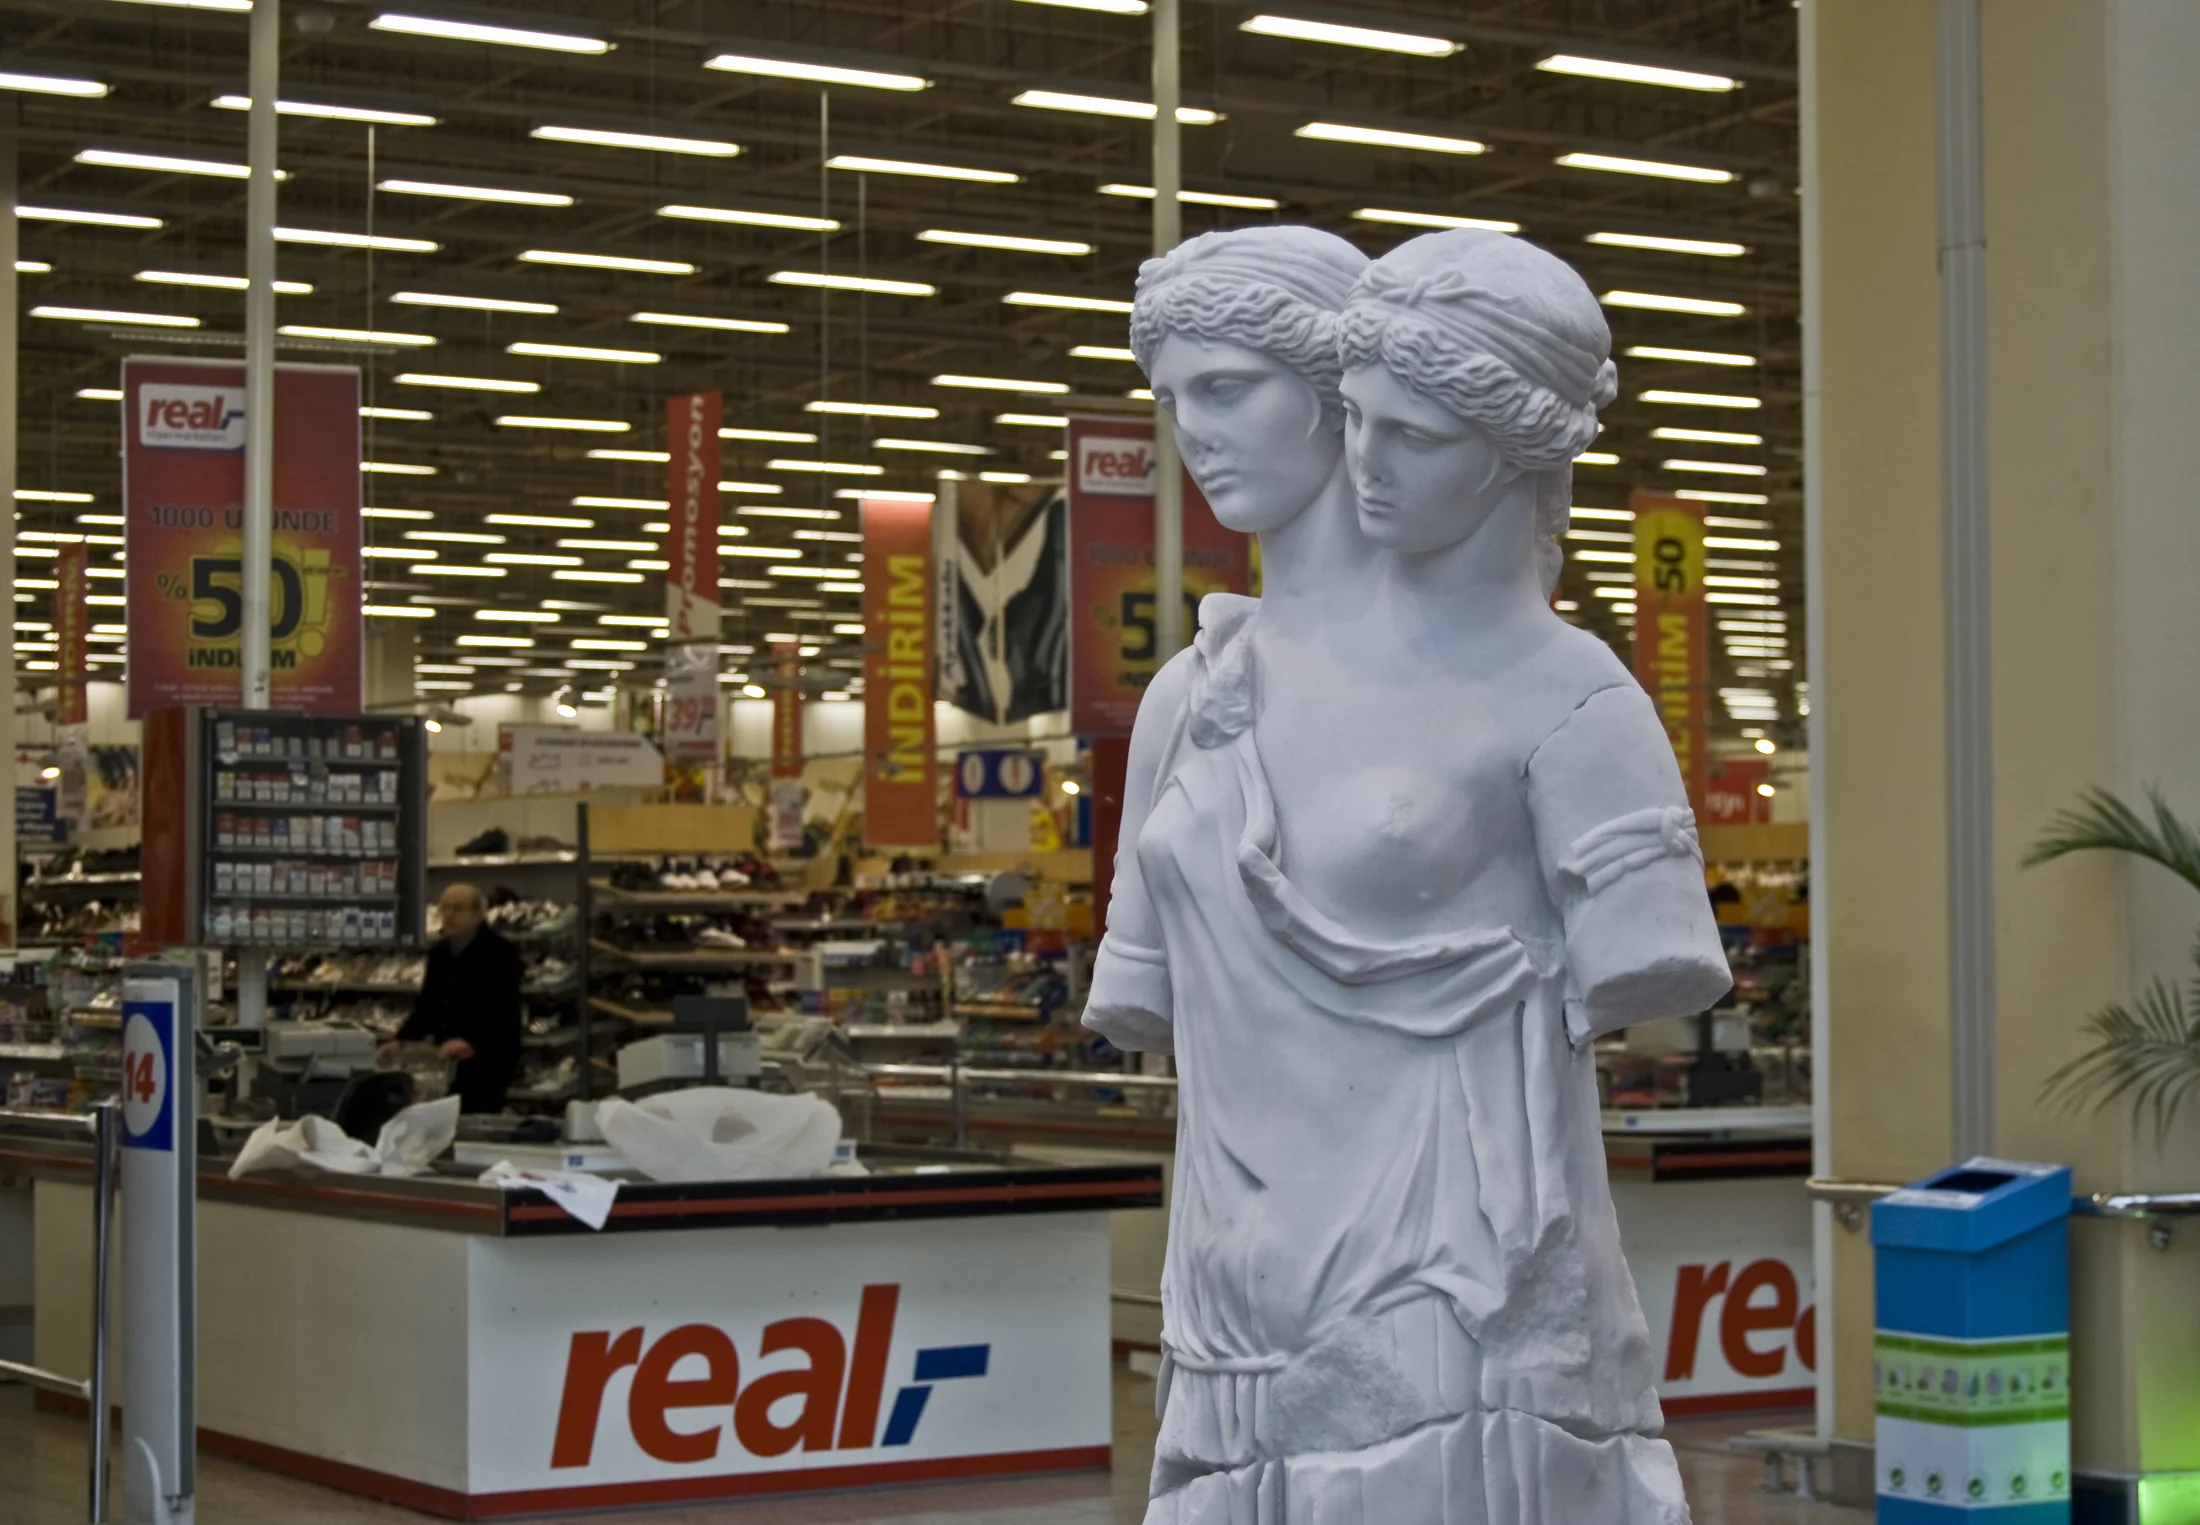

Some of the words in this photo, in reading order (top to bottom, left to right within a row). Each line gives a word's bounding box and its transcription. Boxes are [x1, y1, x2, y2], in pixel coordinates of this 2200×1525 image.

[152, 506, 213, 528] 1000
[1654, 537, 1686, 592] 50
[126, 1051, 156, 1103] 14
